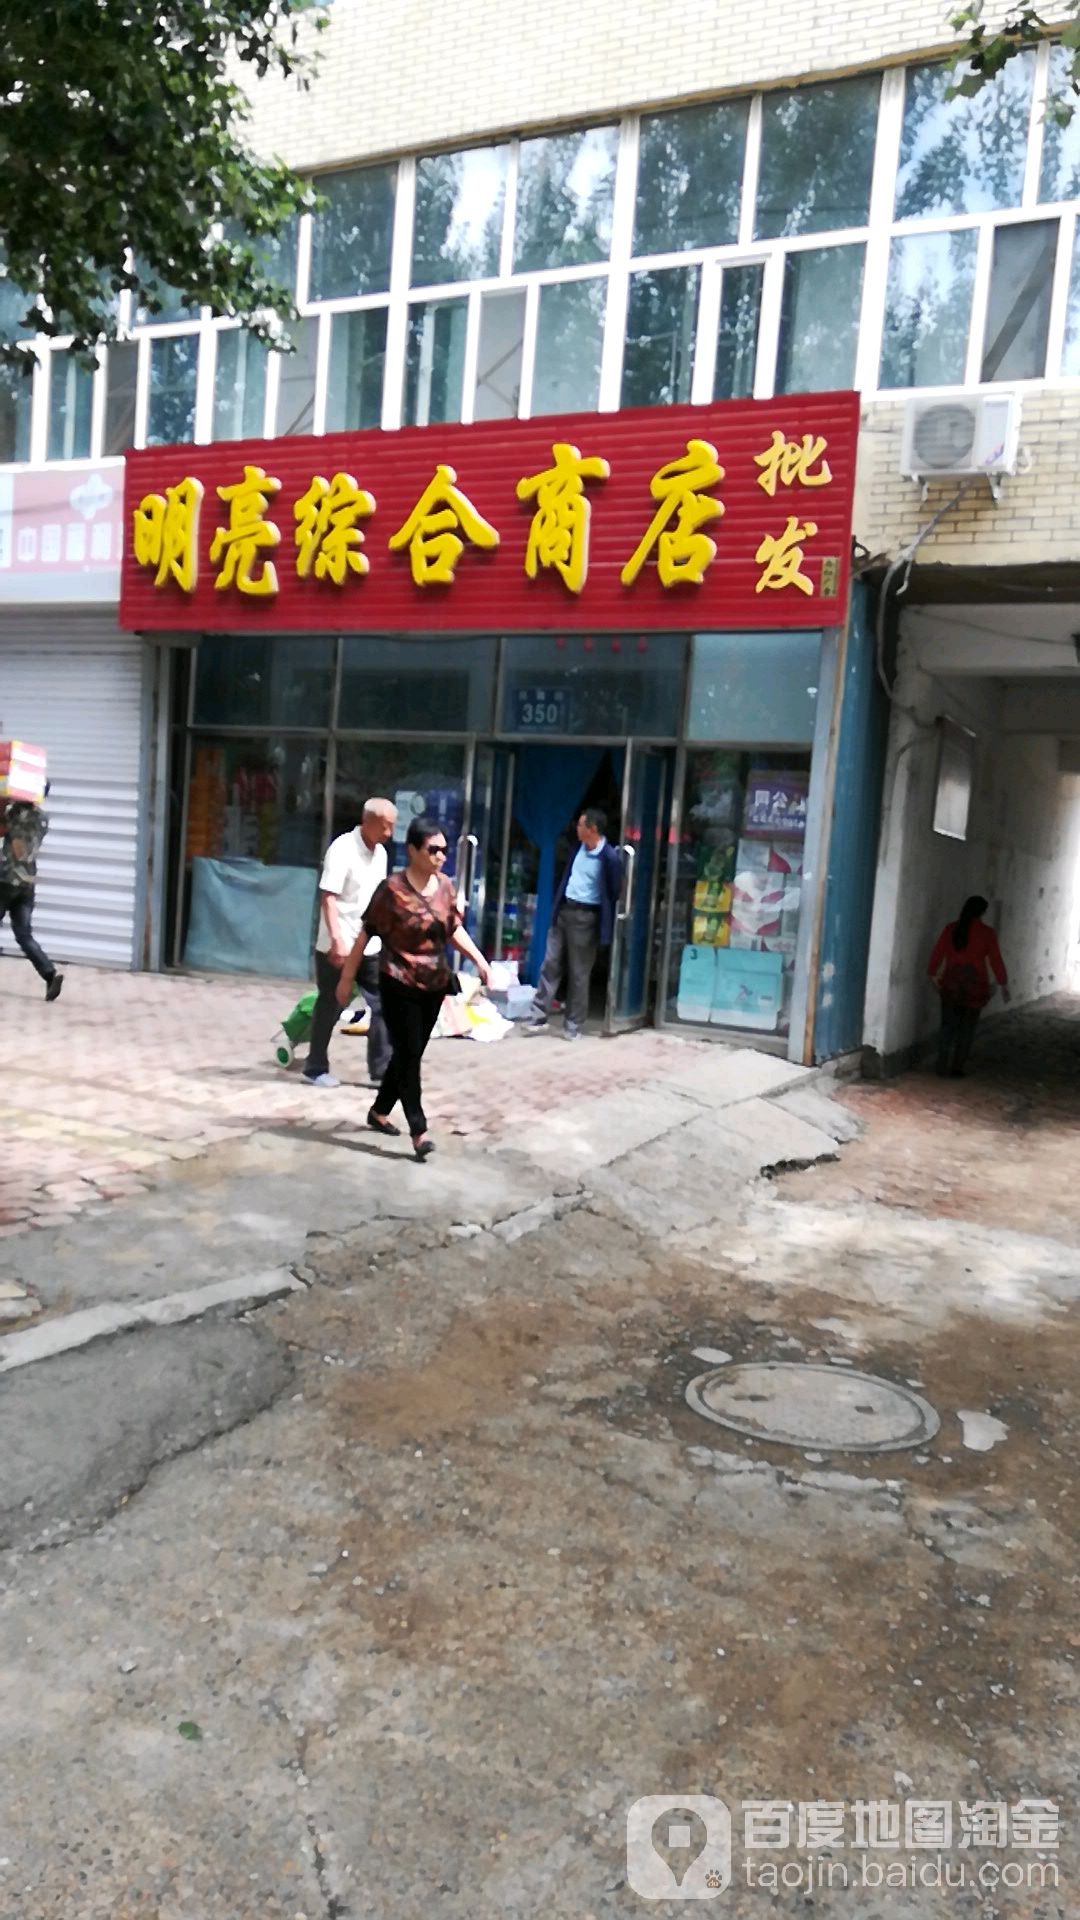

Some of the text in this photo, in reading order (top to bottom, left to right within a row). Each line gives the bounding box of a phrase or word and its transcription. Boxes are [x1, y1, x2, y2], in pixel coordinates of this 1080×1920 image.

[132, 438, 727, 597] 明亮综合商店
[753, 430, 833, 597] 批发
[522, 703, 558, 723] 350
